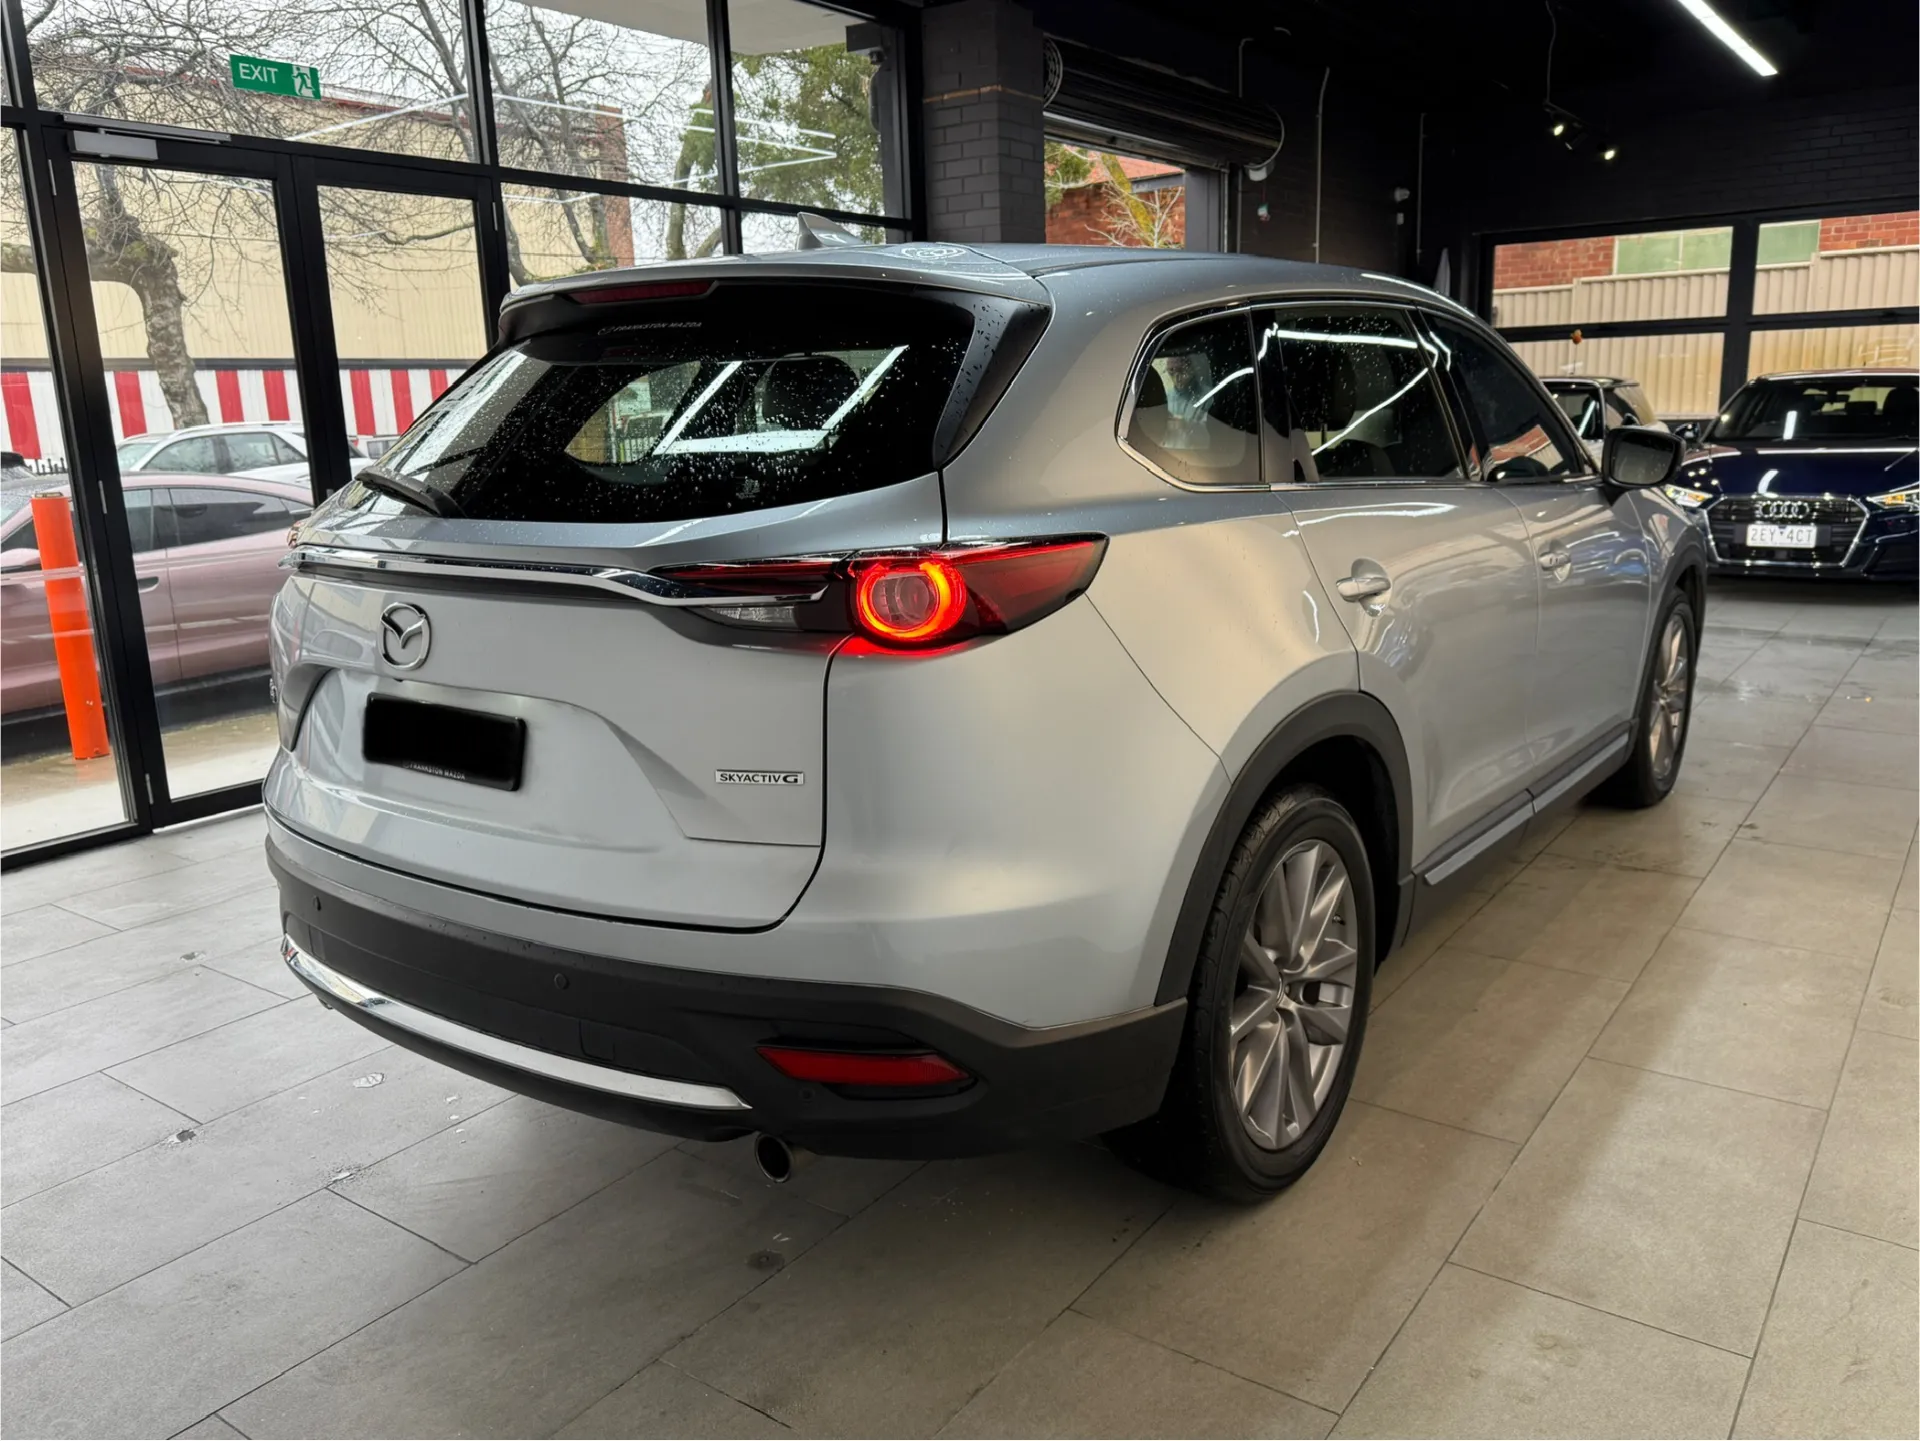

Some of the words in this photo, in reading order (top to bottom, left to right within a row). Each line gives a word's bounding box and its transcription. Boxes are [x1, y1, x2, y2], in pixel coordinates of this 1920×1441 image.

[239, 63, 278, 84] EXIT
[1750, 528, 1776, 543] 2EY
[1786, 528, 1812, 543] 4CT
[444, 769, 466, 780] MAZDA
